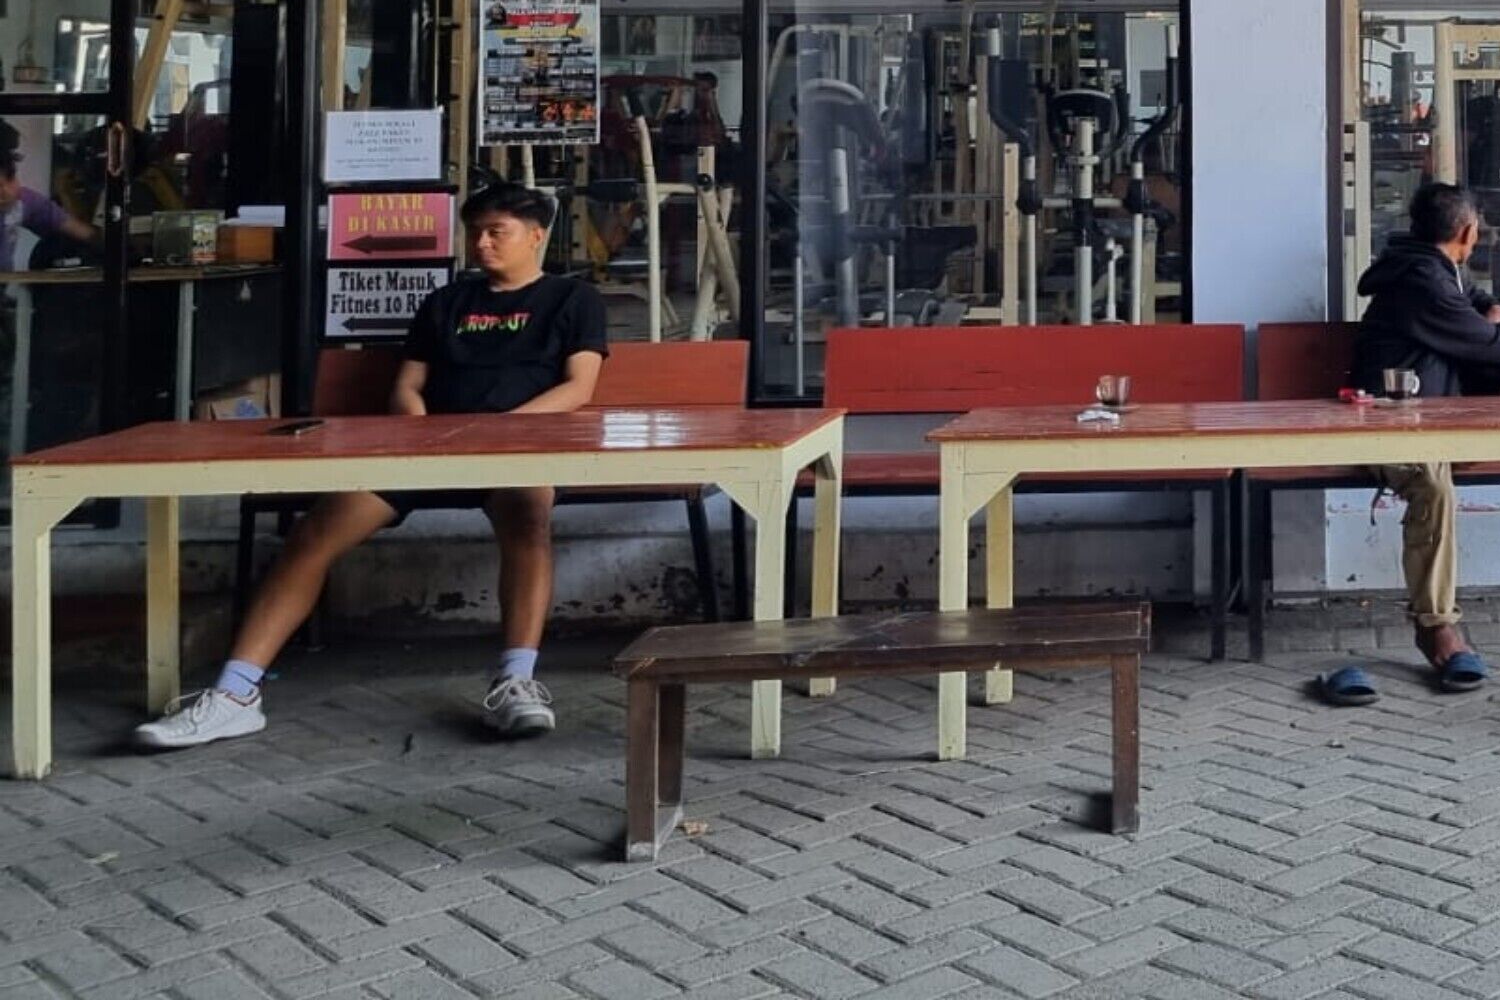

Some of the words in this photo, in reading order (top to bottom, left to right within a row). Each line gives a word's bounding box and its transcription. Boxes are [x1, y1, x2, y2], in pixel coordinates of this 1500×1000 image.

[348, 216, 369, 233] DI
[376, 215, 435, 232] KASIR
[339, 271, 382, 291] Tiket
[384, 270, 436, 292] Masuk
[330, 294, 380, 314] Fitnes
[384, 295, 402, 313] 10
